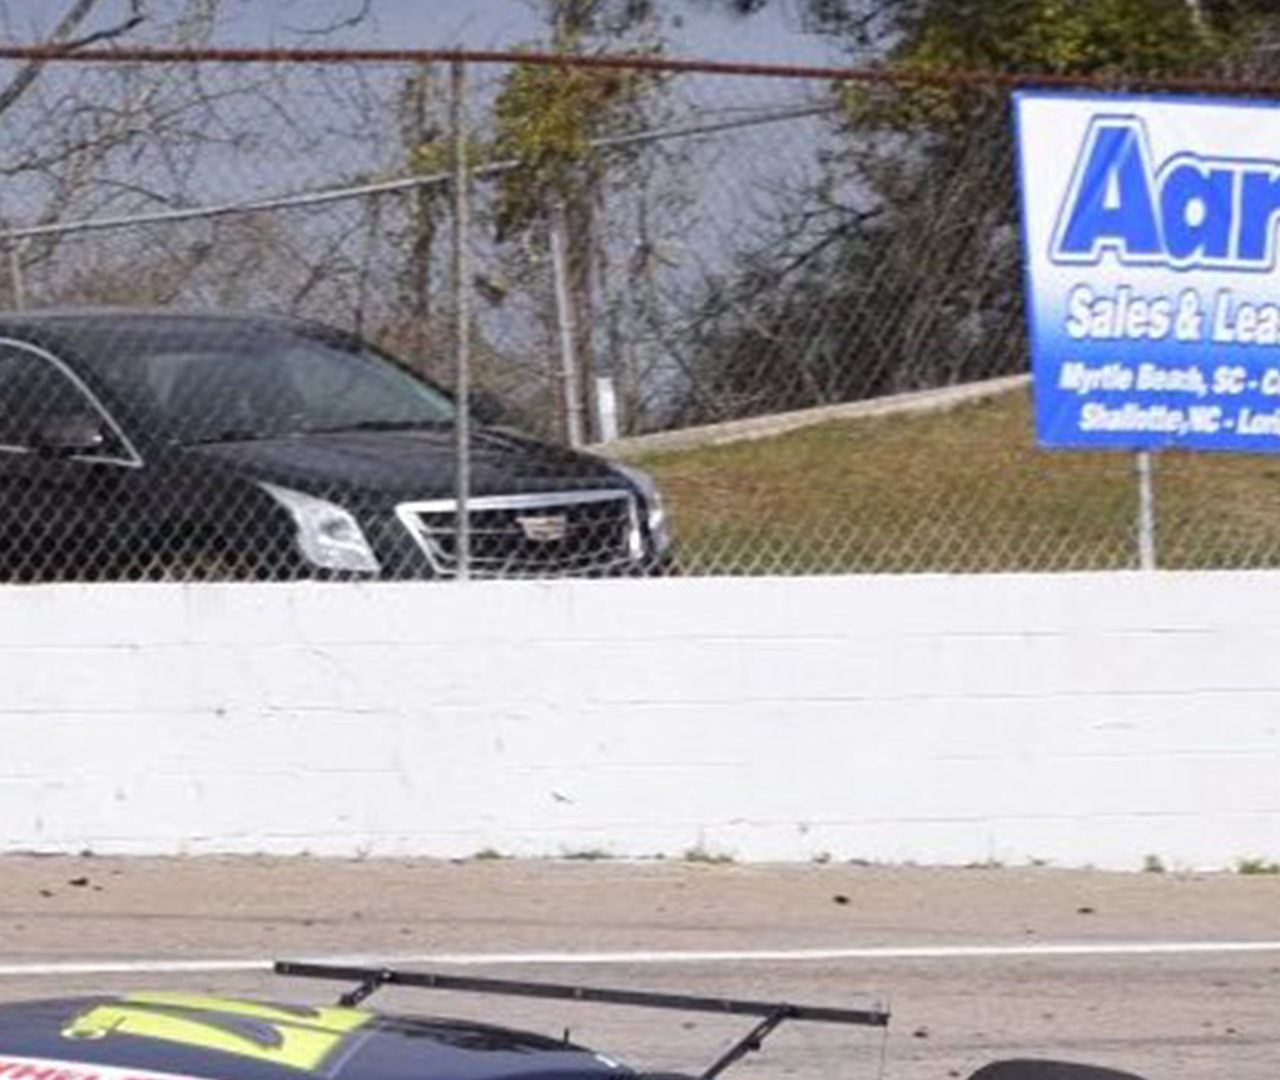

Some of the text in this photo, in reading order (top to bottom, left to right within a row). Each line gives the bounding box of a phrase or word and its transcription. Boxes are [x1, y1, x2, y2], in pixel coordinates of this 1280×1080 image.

[1066, 284, 1170, 341] Sales
[1175, 288, 1204, 342] &
[1059, 362, 1133, 395] Myrtle
[1136, 363, 1208, 397] Beach,
[1213, 365, 1247, 395] SC
